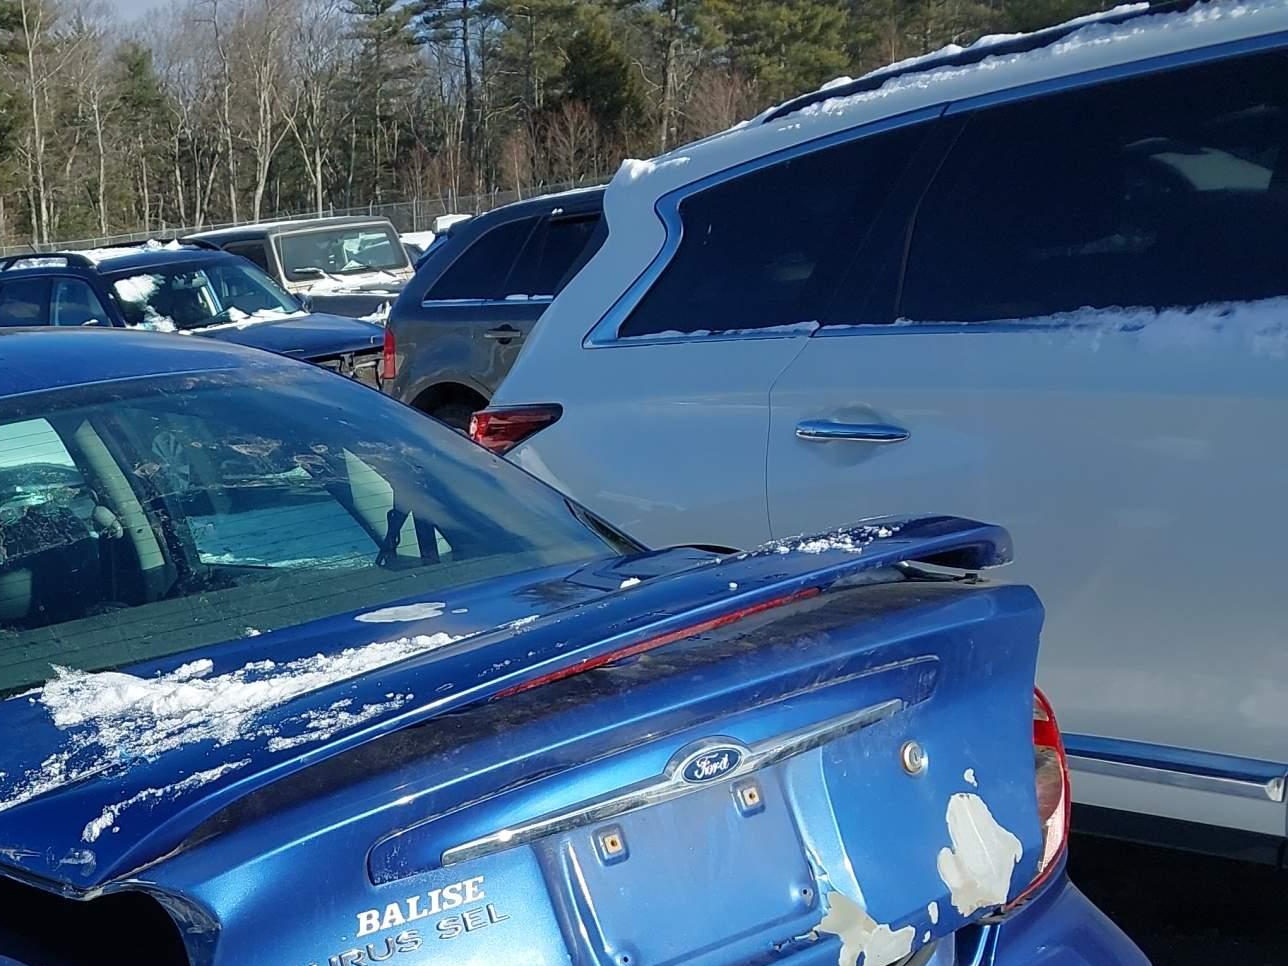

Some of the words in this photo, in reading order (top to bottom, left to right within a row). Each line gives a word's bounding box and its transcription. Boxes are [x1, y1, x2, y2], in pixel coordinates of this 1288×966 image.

[694, 752, 730, 779] Ford
[356, 875, 486, 938] BALISE
[436, 903, 511, 941] SEL
